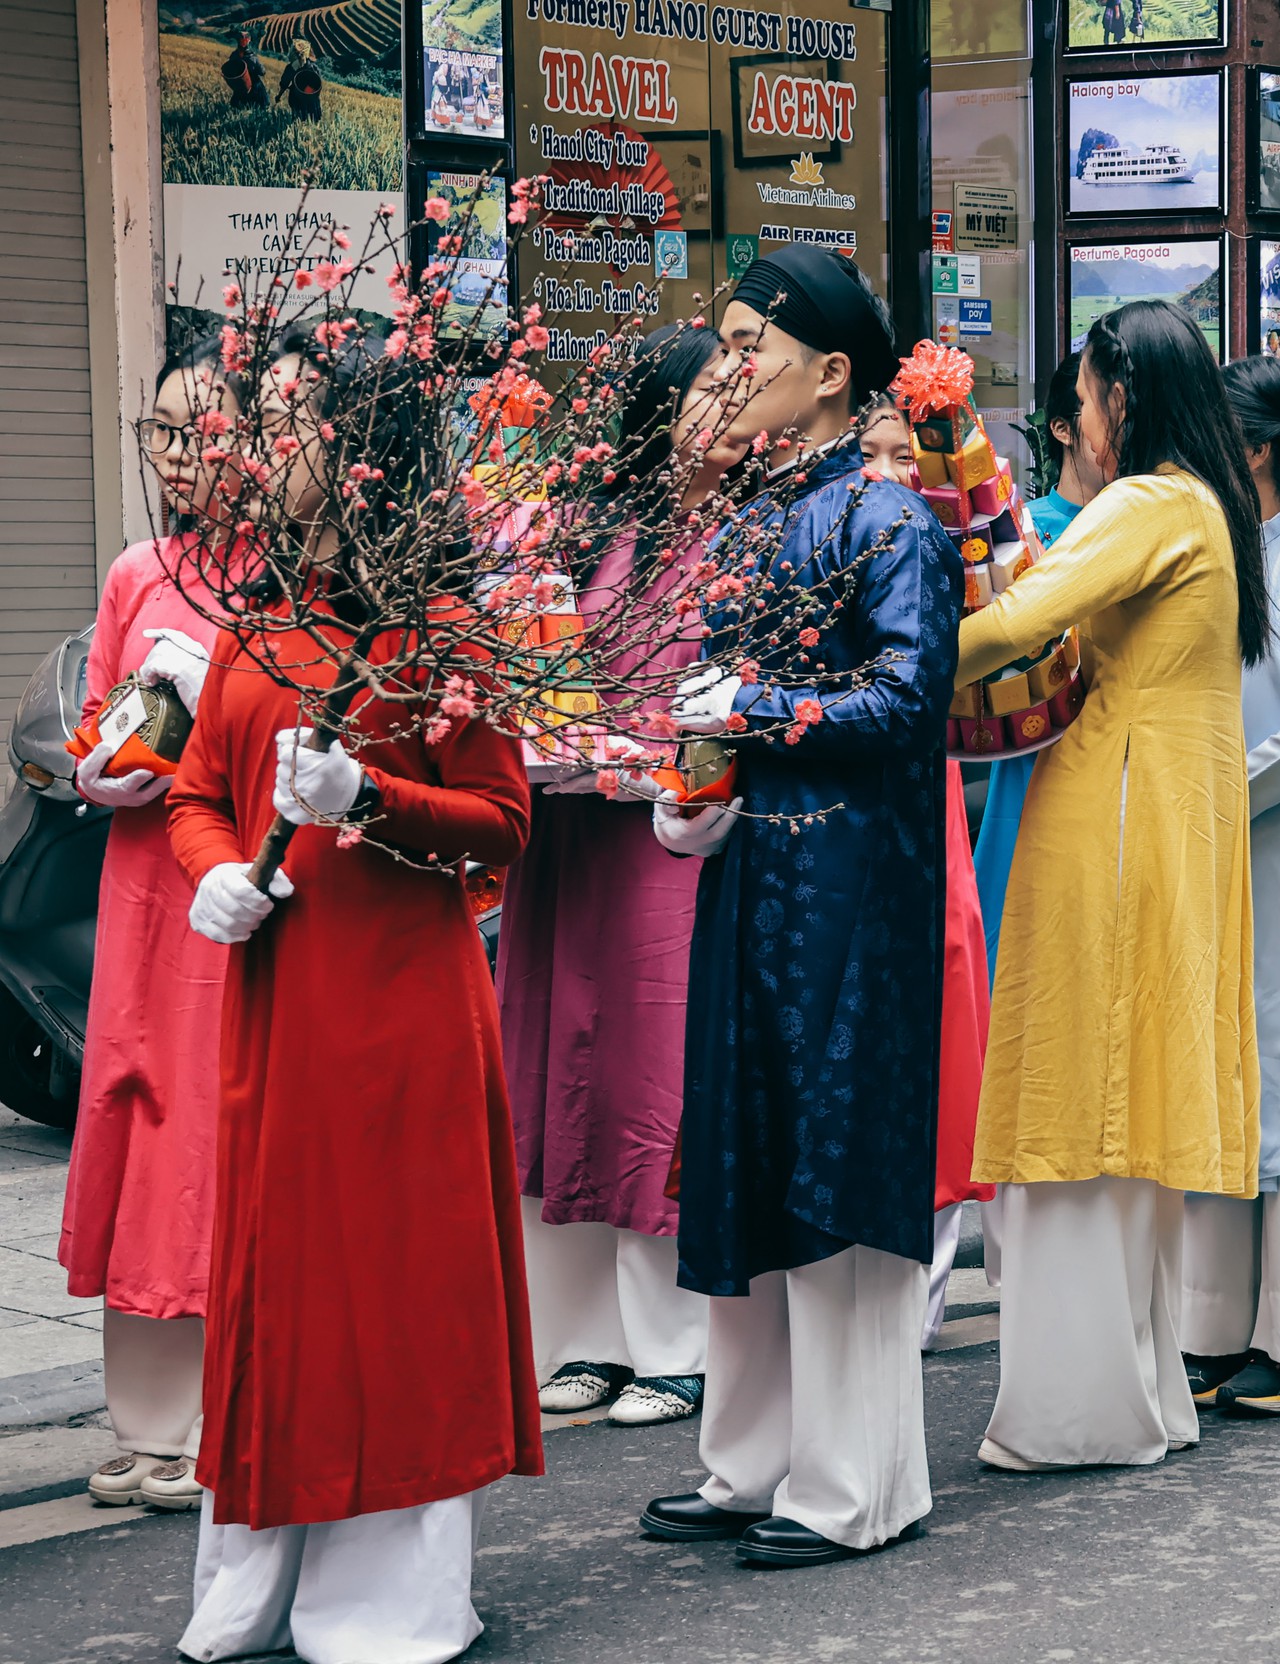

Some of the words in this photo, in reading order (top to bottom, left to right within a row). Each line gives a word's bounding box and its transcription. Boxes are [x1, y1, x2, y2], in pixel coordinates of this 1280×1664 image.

[527, 0, 629, 38] Formerly
[633, 0, 707, 42] HANOI
[711, 6, 782, 51] GUEST
[786, 17, 856, 61] HOUSE
[539, 46, 677, 124] TRAVEL
[1071, 84, 1114, 99] Halong
[1117, 82, 1140, 96] bay
[749, 72, 856, 142] AGENT
[541, 125, 583, 161] Hanoi
[584, 128, 613, 170] City
[615, 131, 648, 166] Tour
[441, 173, 466, 187] NINH
[543, 176, 619, 213] Traditional
[620, 184, 665, 223] village
[757, 182, 811, 206] Vietnam
[812, 187, 855, 210] Airlines
[228, 213, 278, 231] THAM
[760, 224, 791, 242] AIR
[793, 227, 856, 246] FRANCE
[966, 211, 982, 232] MỸ
[985, 212, 1007, 237] VIỆT
[262, 234, 303, 251] CAVE
[544, 228, 601, 263] Perfume
[602, 231, 650, 272] Pagoda
[1073, 248, 1120, 261] Perfume
[1124, 246, 1170, 262] Pagoda
[463, 261, 492, 274] CHAU
[546, 278, 574, 312] Hoa
[573, 279, 594, 312] Lu
[602, 280, 634, 314] Tam
[963, 301, 988, 309] SAMSUNG
[968, 310, 983, 320] pay
[547, 328, 595, 368] Halong
